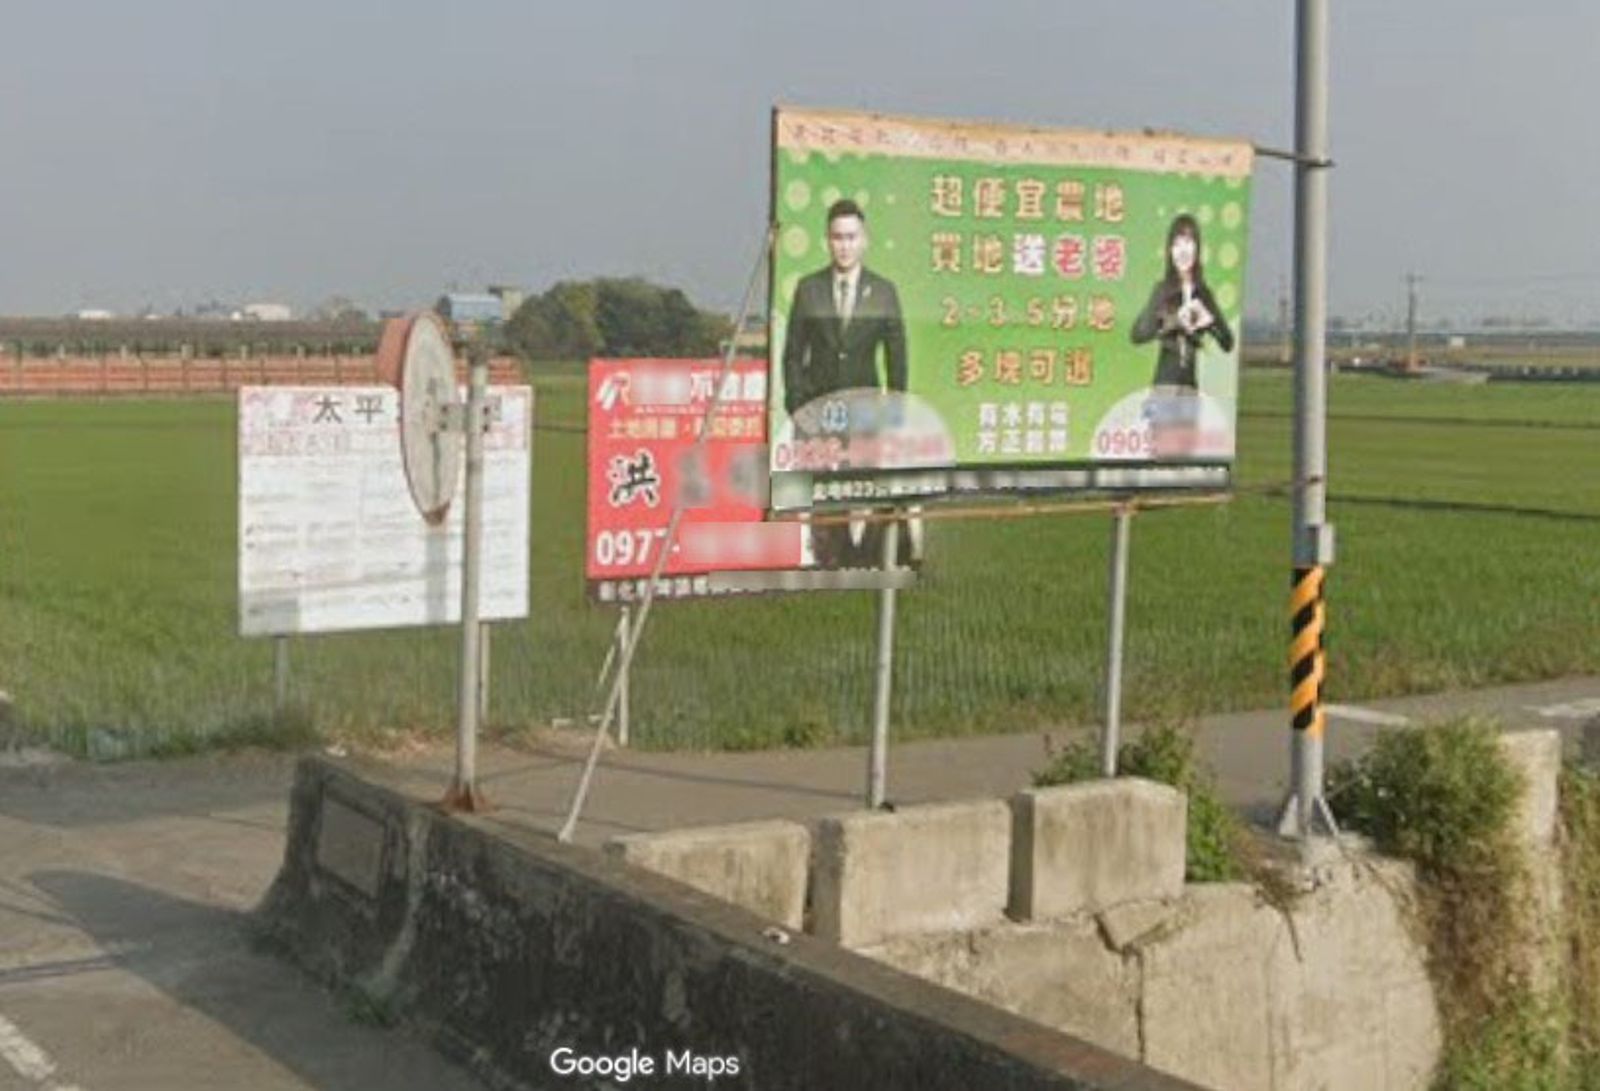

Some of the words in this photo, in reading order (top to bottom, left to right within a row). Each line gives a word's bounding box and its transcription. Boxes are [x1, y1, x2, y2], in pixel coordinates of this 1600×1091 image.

[931, 174, 1125, 223] 超便宜農地
[931, 231, 1128, 281] 買地送老婆
[608, 449, 661, 508] 洪
